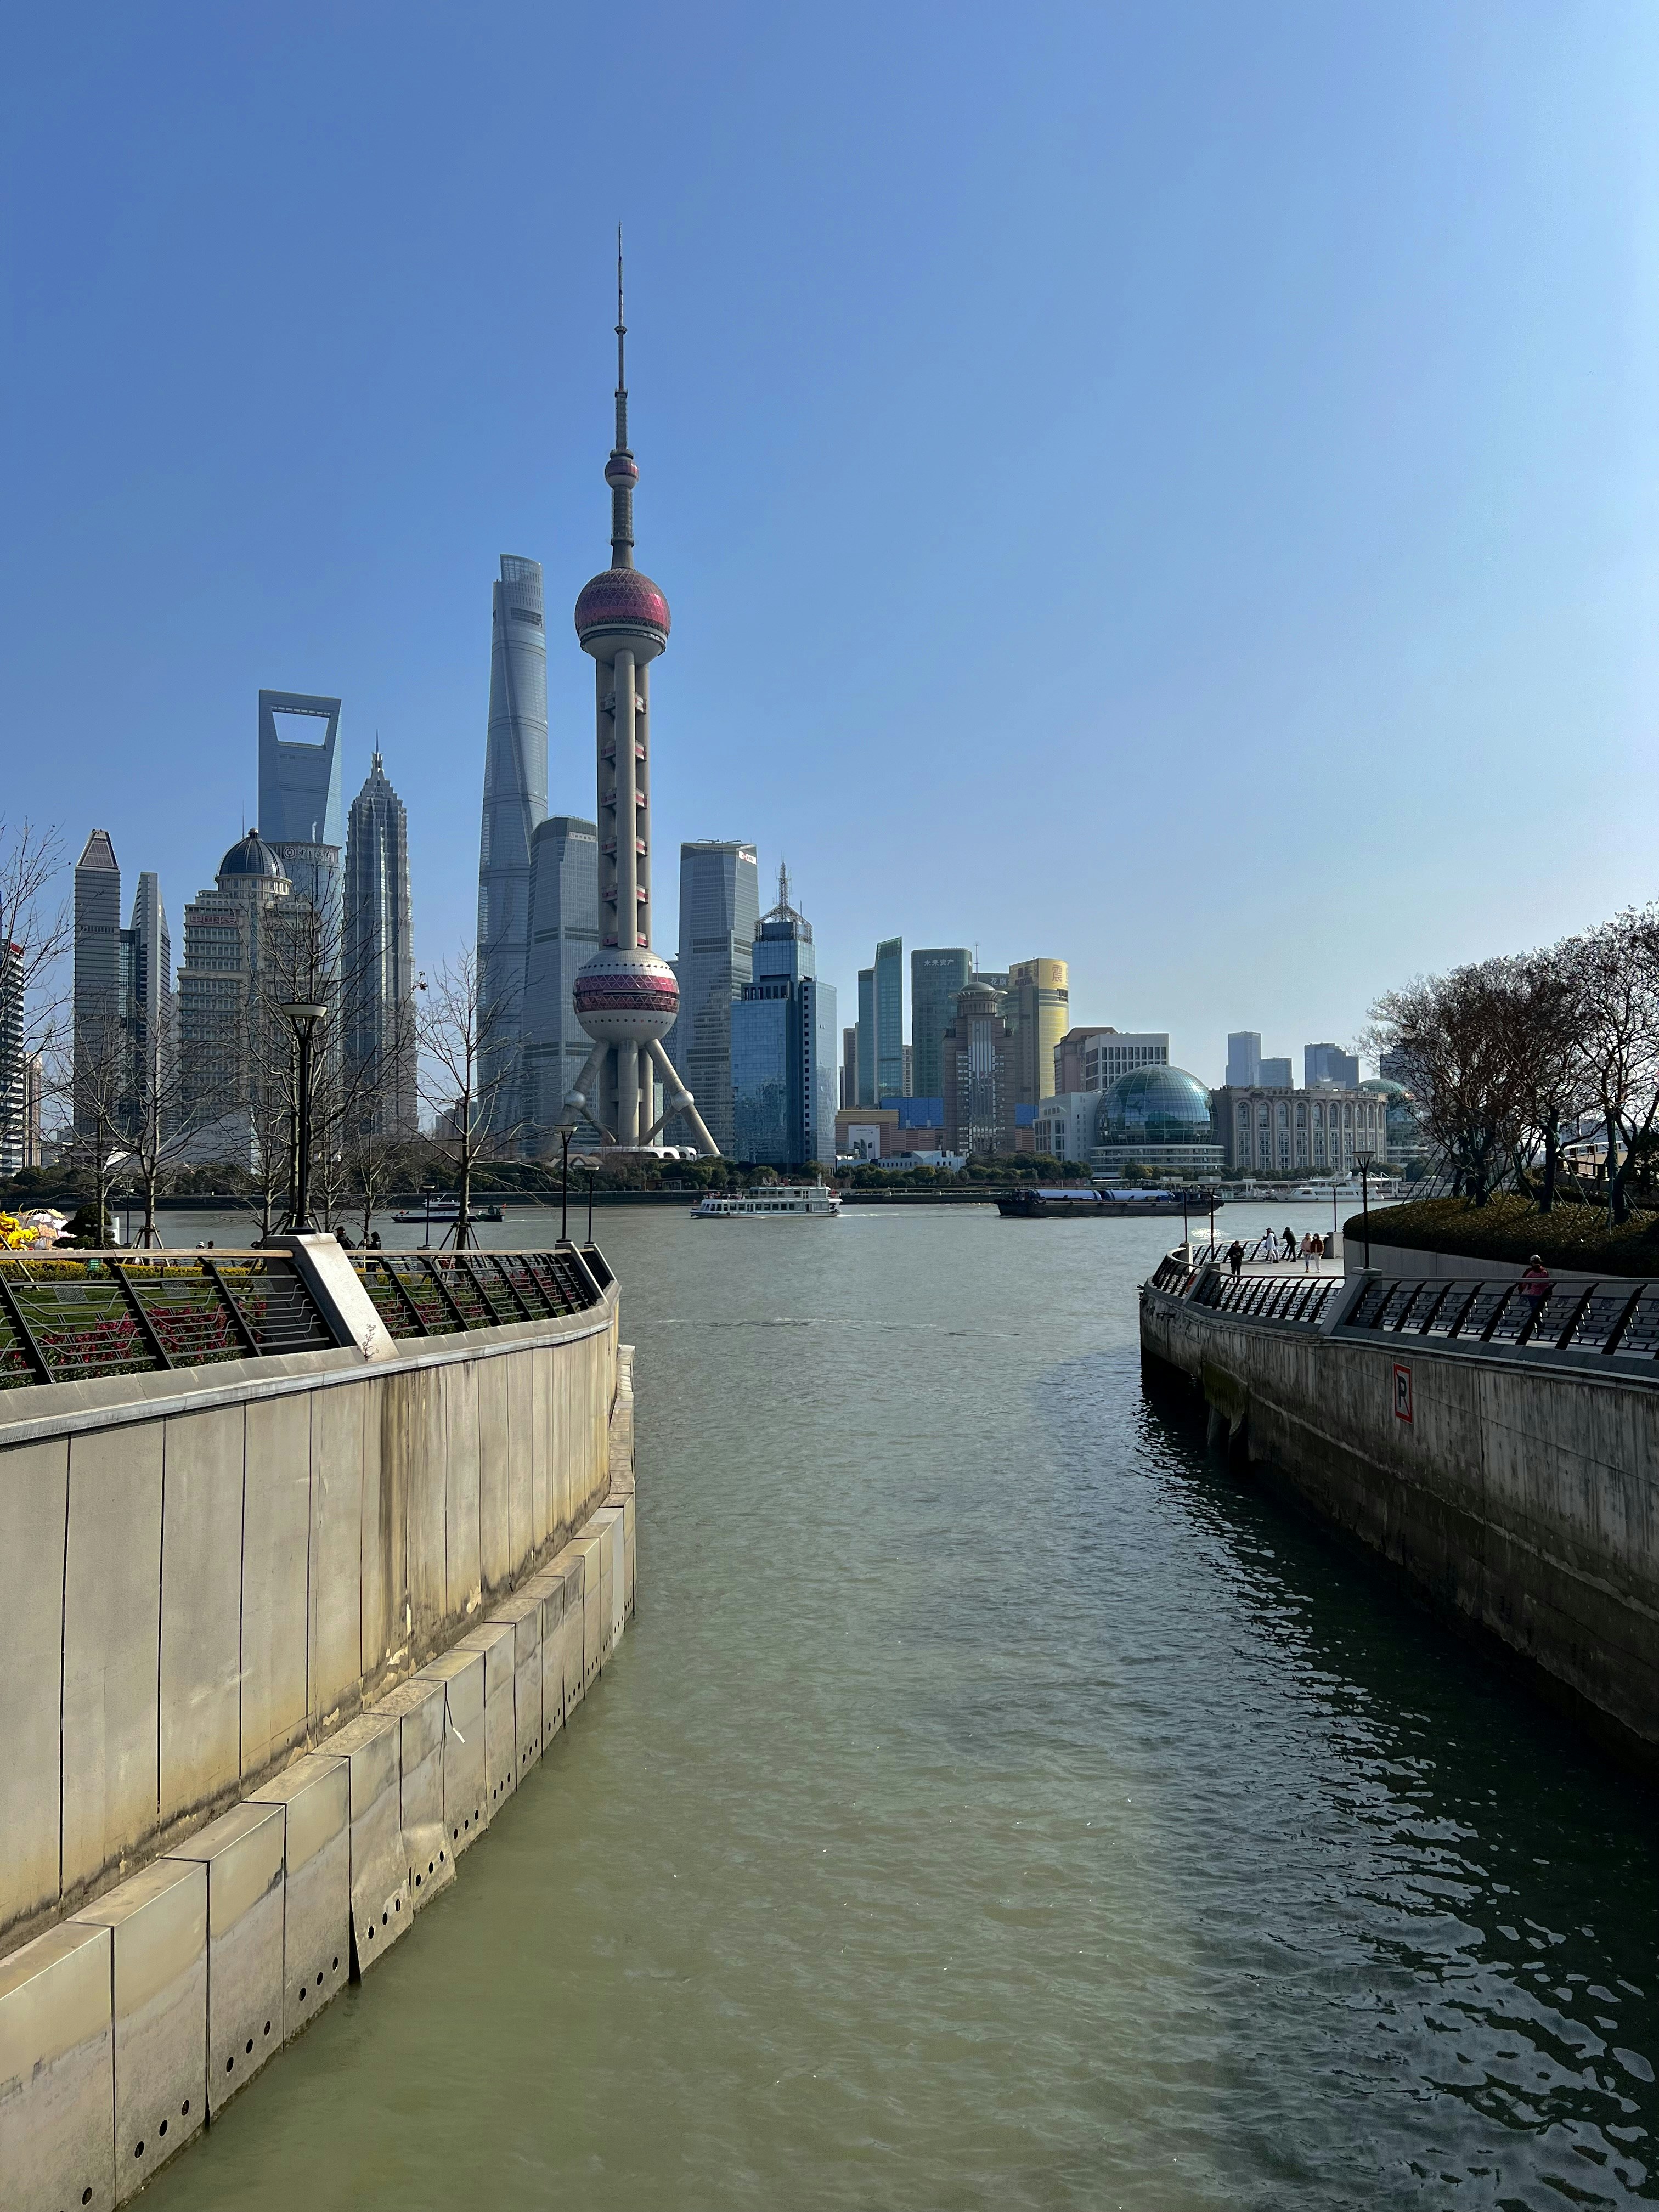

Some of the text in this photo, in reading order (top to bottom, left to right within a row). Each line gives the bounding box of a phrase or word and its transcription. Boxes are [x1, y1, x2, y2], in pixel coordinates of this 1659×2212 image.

[191, 915, 237, 925] 中国平安
[1052, 964, 1063, 982] 震
[990, 977, 1007, 986] 花旗
